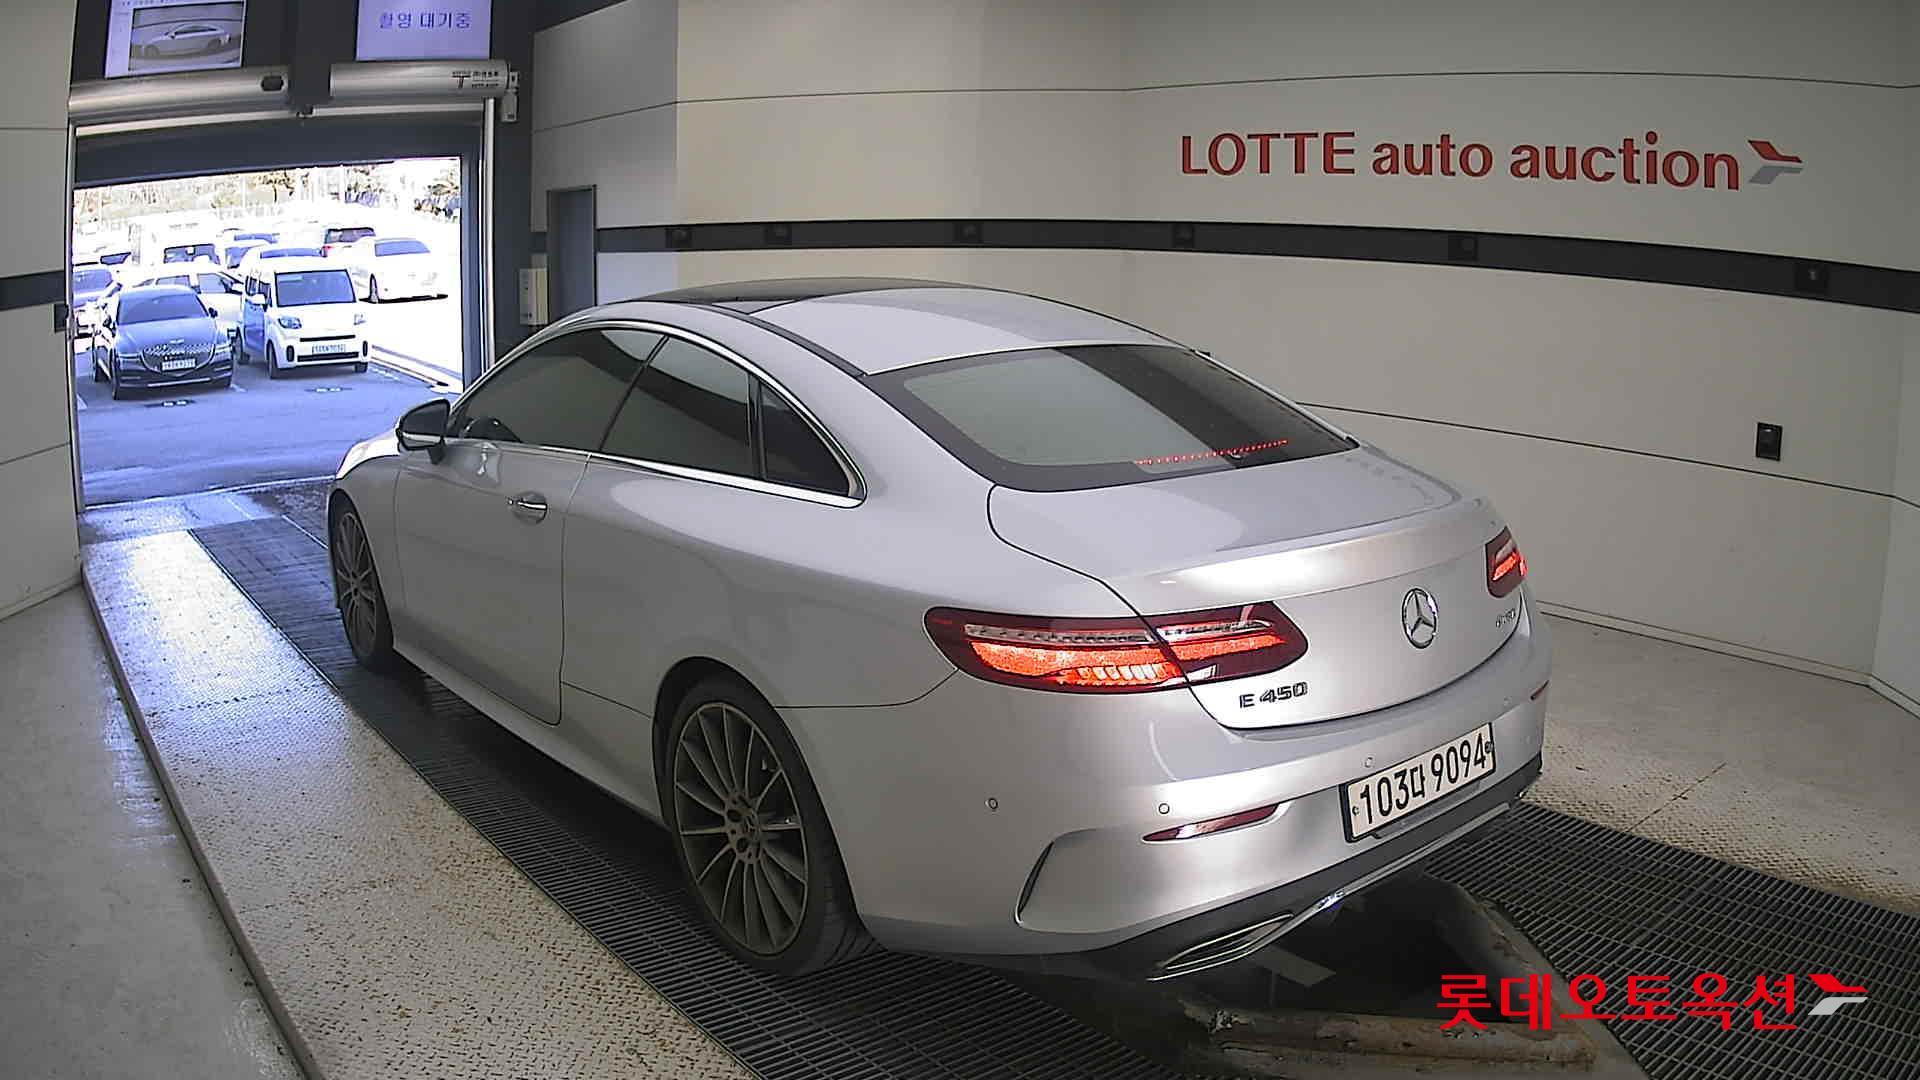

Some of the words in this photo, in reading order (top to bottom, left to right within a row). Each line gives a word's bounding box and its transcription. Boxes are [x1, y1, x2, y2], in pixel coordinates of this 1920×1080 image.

[420, 12, 471, 29] 대기중
[1180, 131, 1355, 175] LOTTE
[1371, 134, 1493, 177] auto
[1509, 131, 1739, 190] auction
[1239, 694, 1255, 708] E
[1260, 682, 1308, 703] 450
[1431, 733, 1486, 792] 9094
